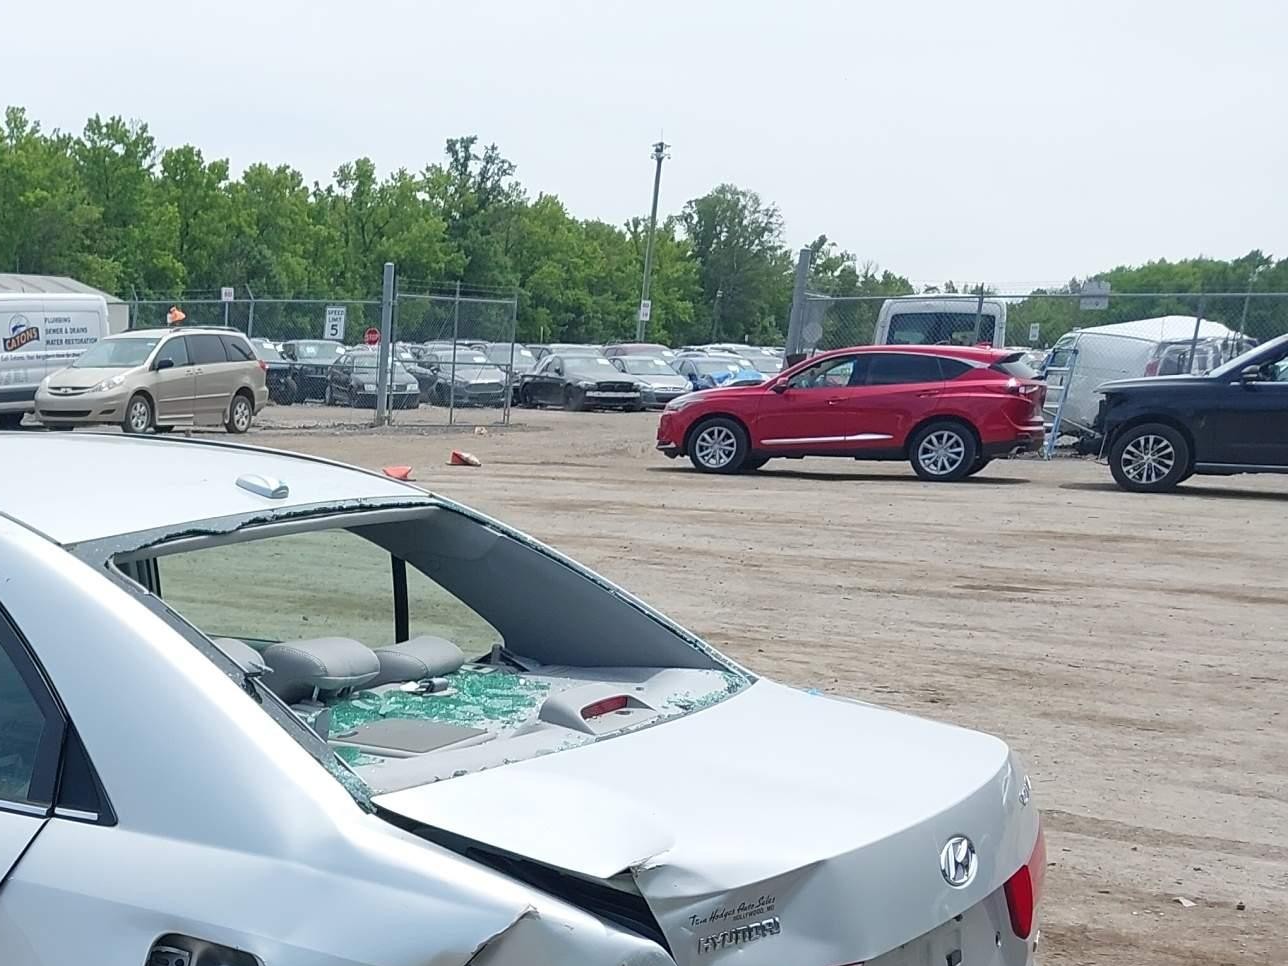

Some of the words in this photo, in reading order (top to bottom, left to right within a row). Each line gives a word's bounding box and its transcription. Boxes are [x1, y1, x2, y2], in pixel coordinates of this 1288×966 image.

[5, 327, 38, 351] CATONS
[330, 324, 338, 336] 5
[697, 916, 781, 955] HYUNDAI
